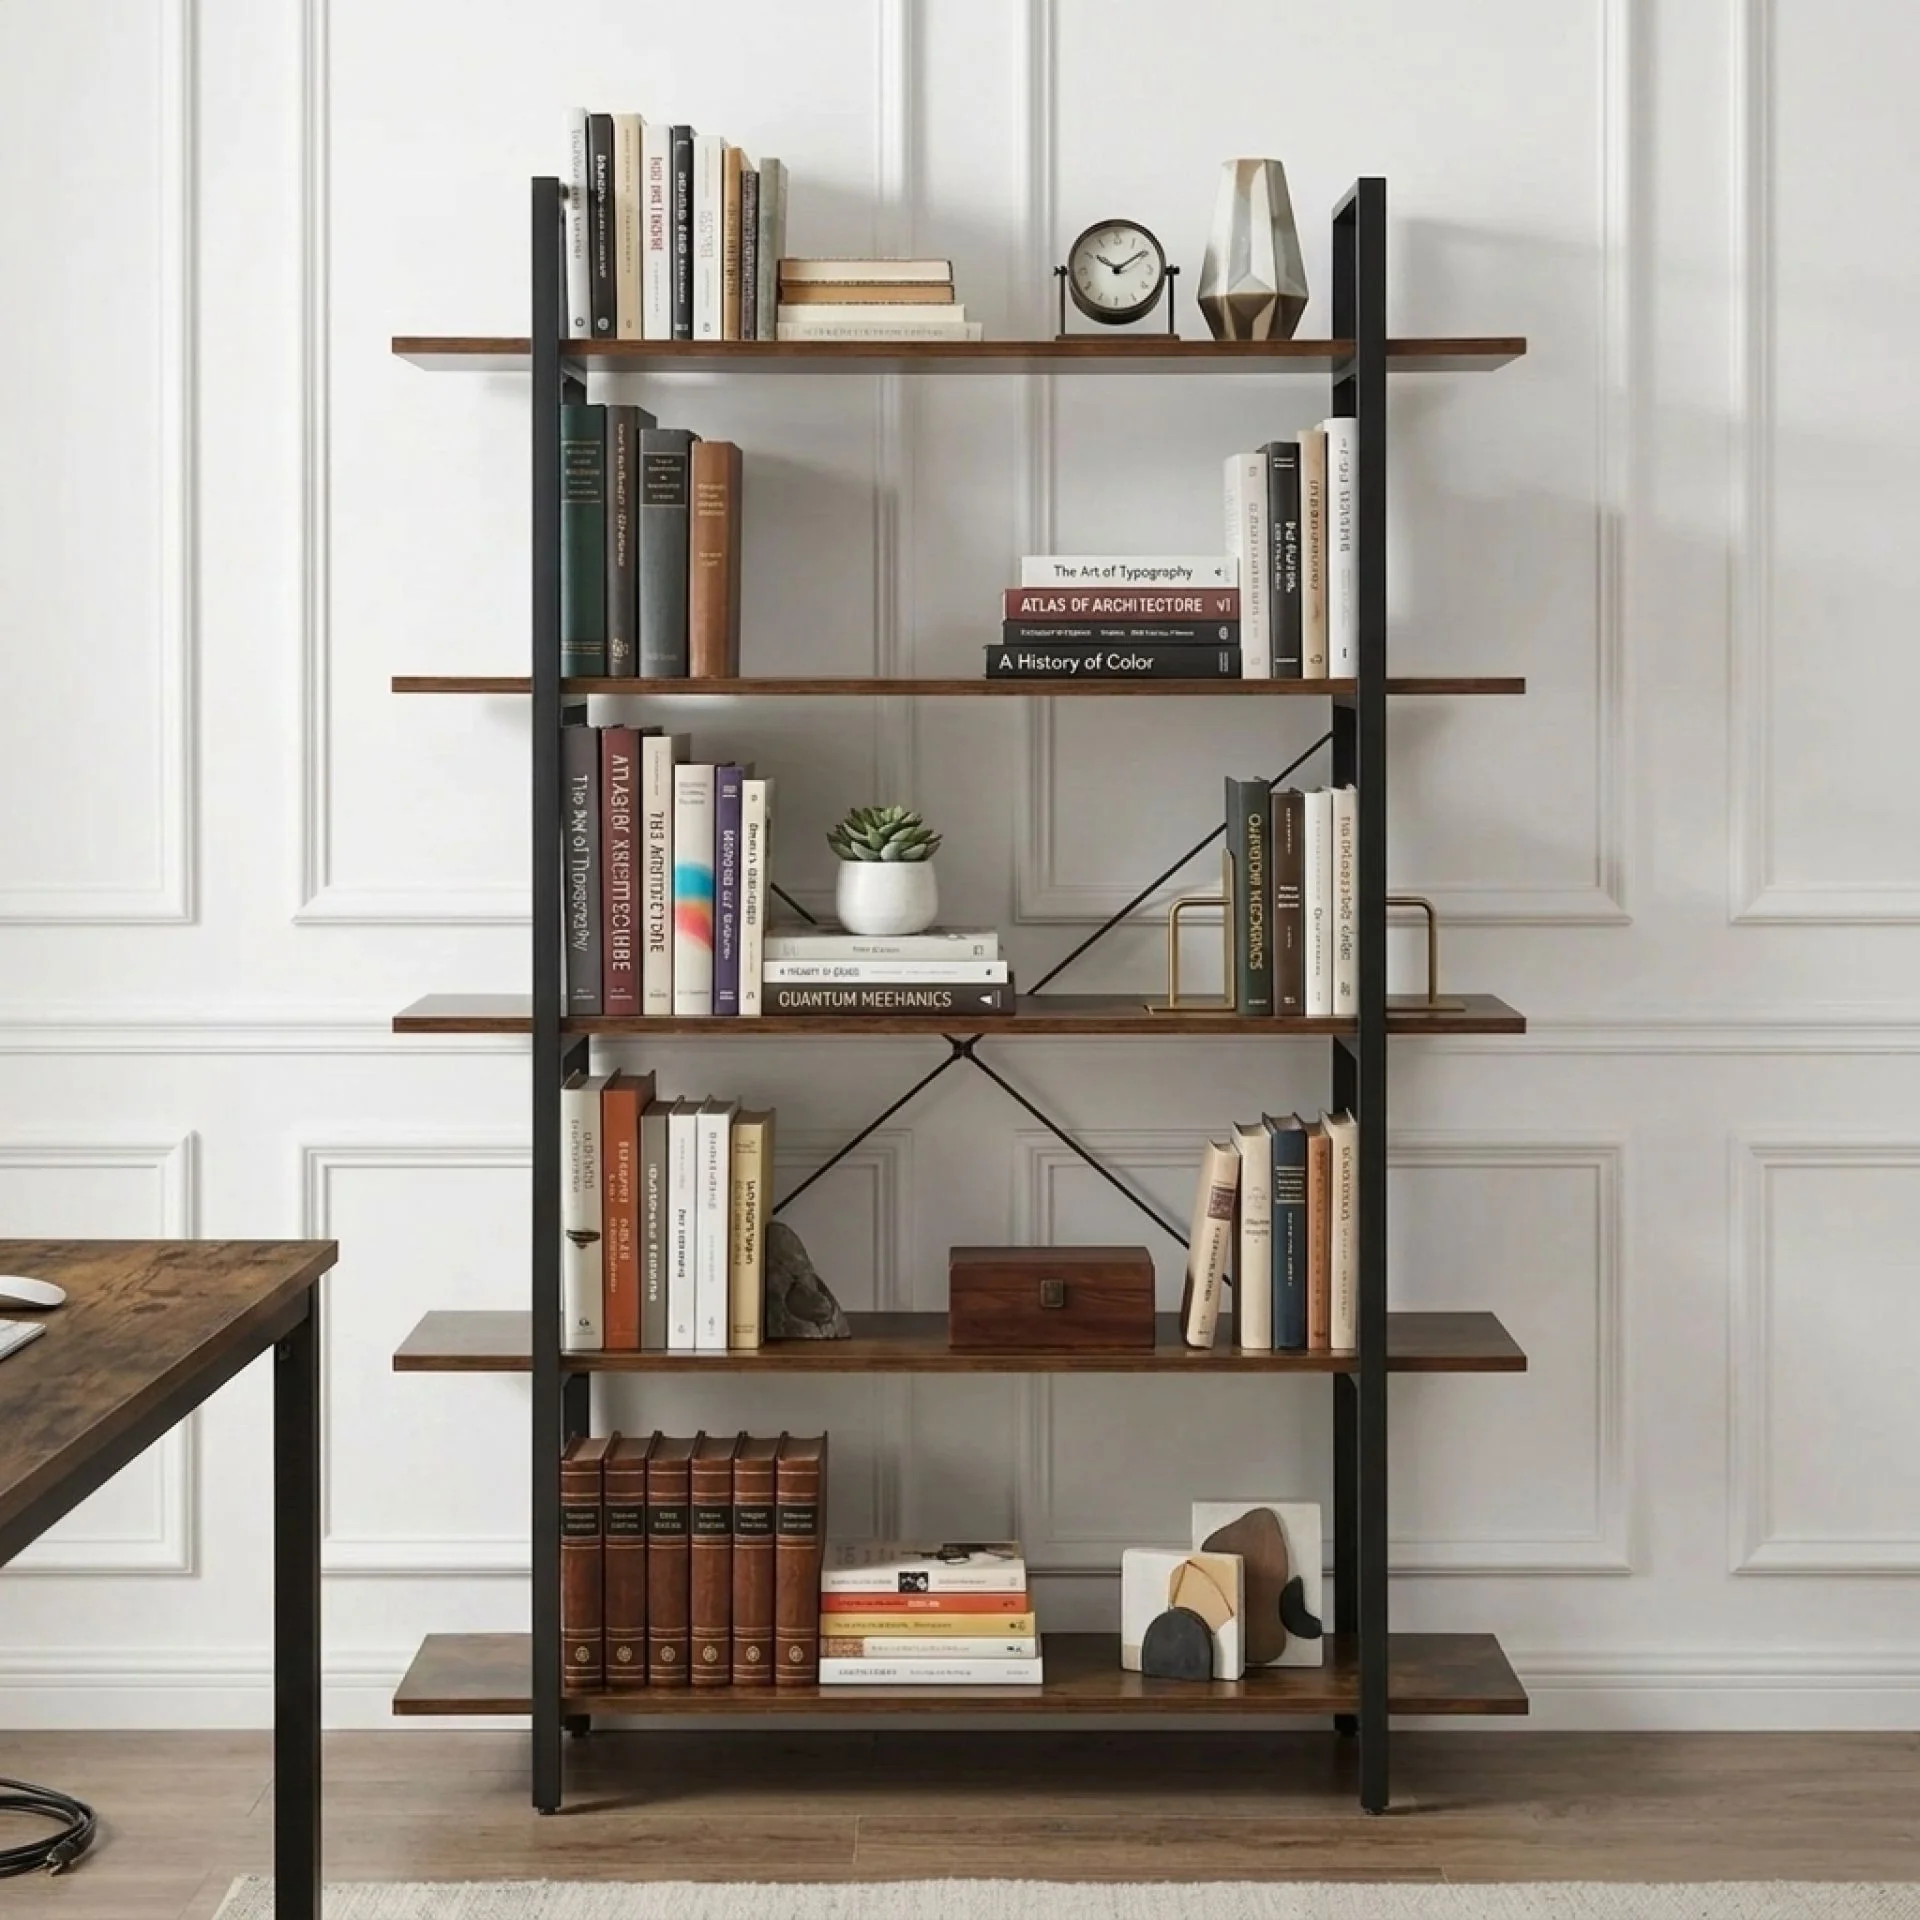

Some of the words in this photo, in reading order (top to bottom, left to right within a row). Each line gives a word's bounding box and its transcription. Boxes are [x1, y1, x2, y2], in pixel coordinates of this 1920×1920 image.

[1053, 565, 1077, 577] The
[1081, 565, 1100, 578] Art
[1102, 564, 1116, 578] of
[1120, 565, 1193, 581] Typography
[1020, 597, 1066, 613] ATLAS
[1071, 597, 1089, 613] OF
[999, 653, 1013, 670] A
[1018, 653, 1080, 674] History
[1084, 653, 1103, 670] of
[1107, 653, 1154, 670] Color
[779, 991, 857, 1008] QUANTUM
